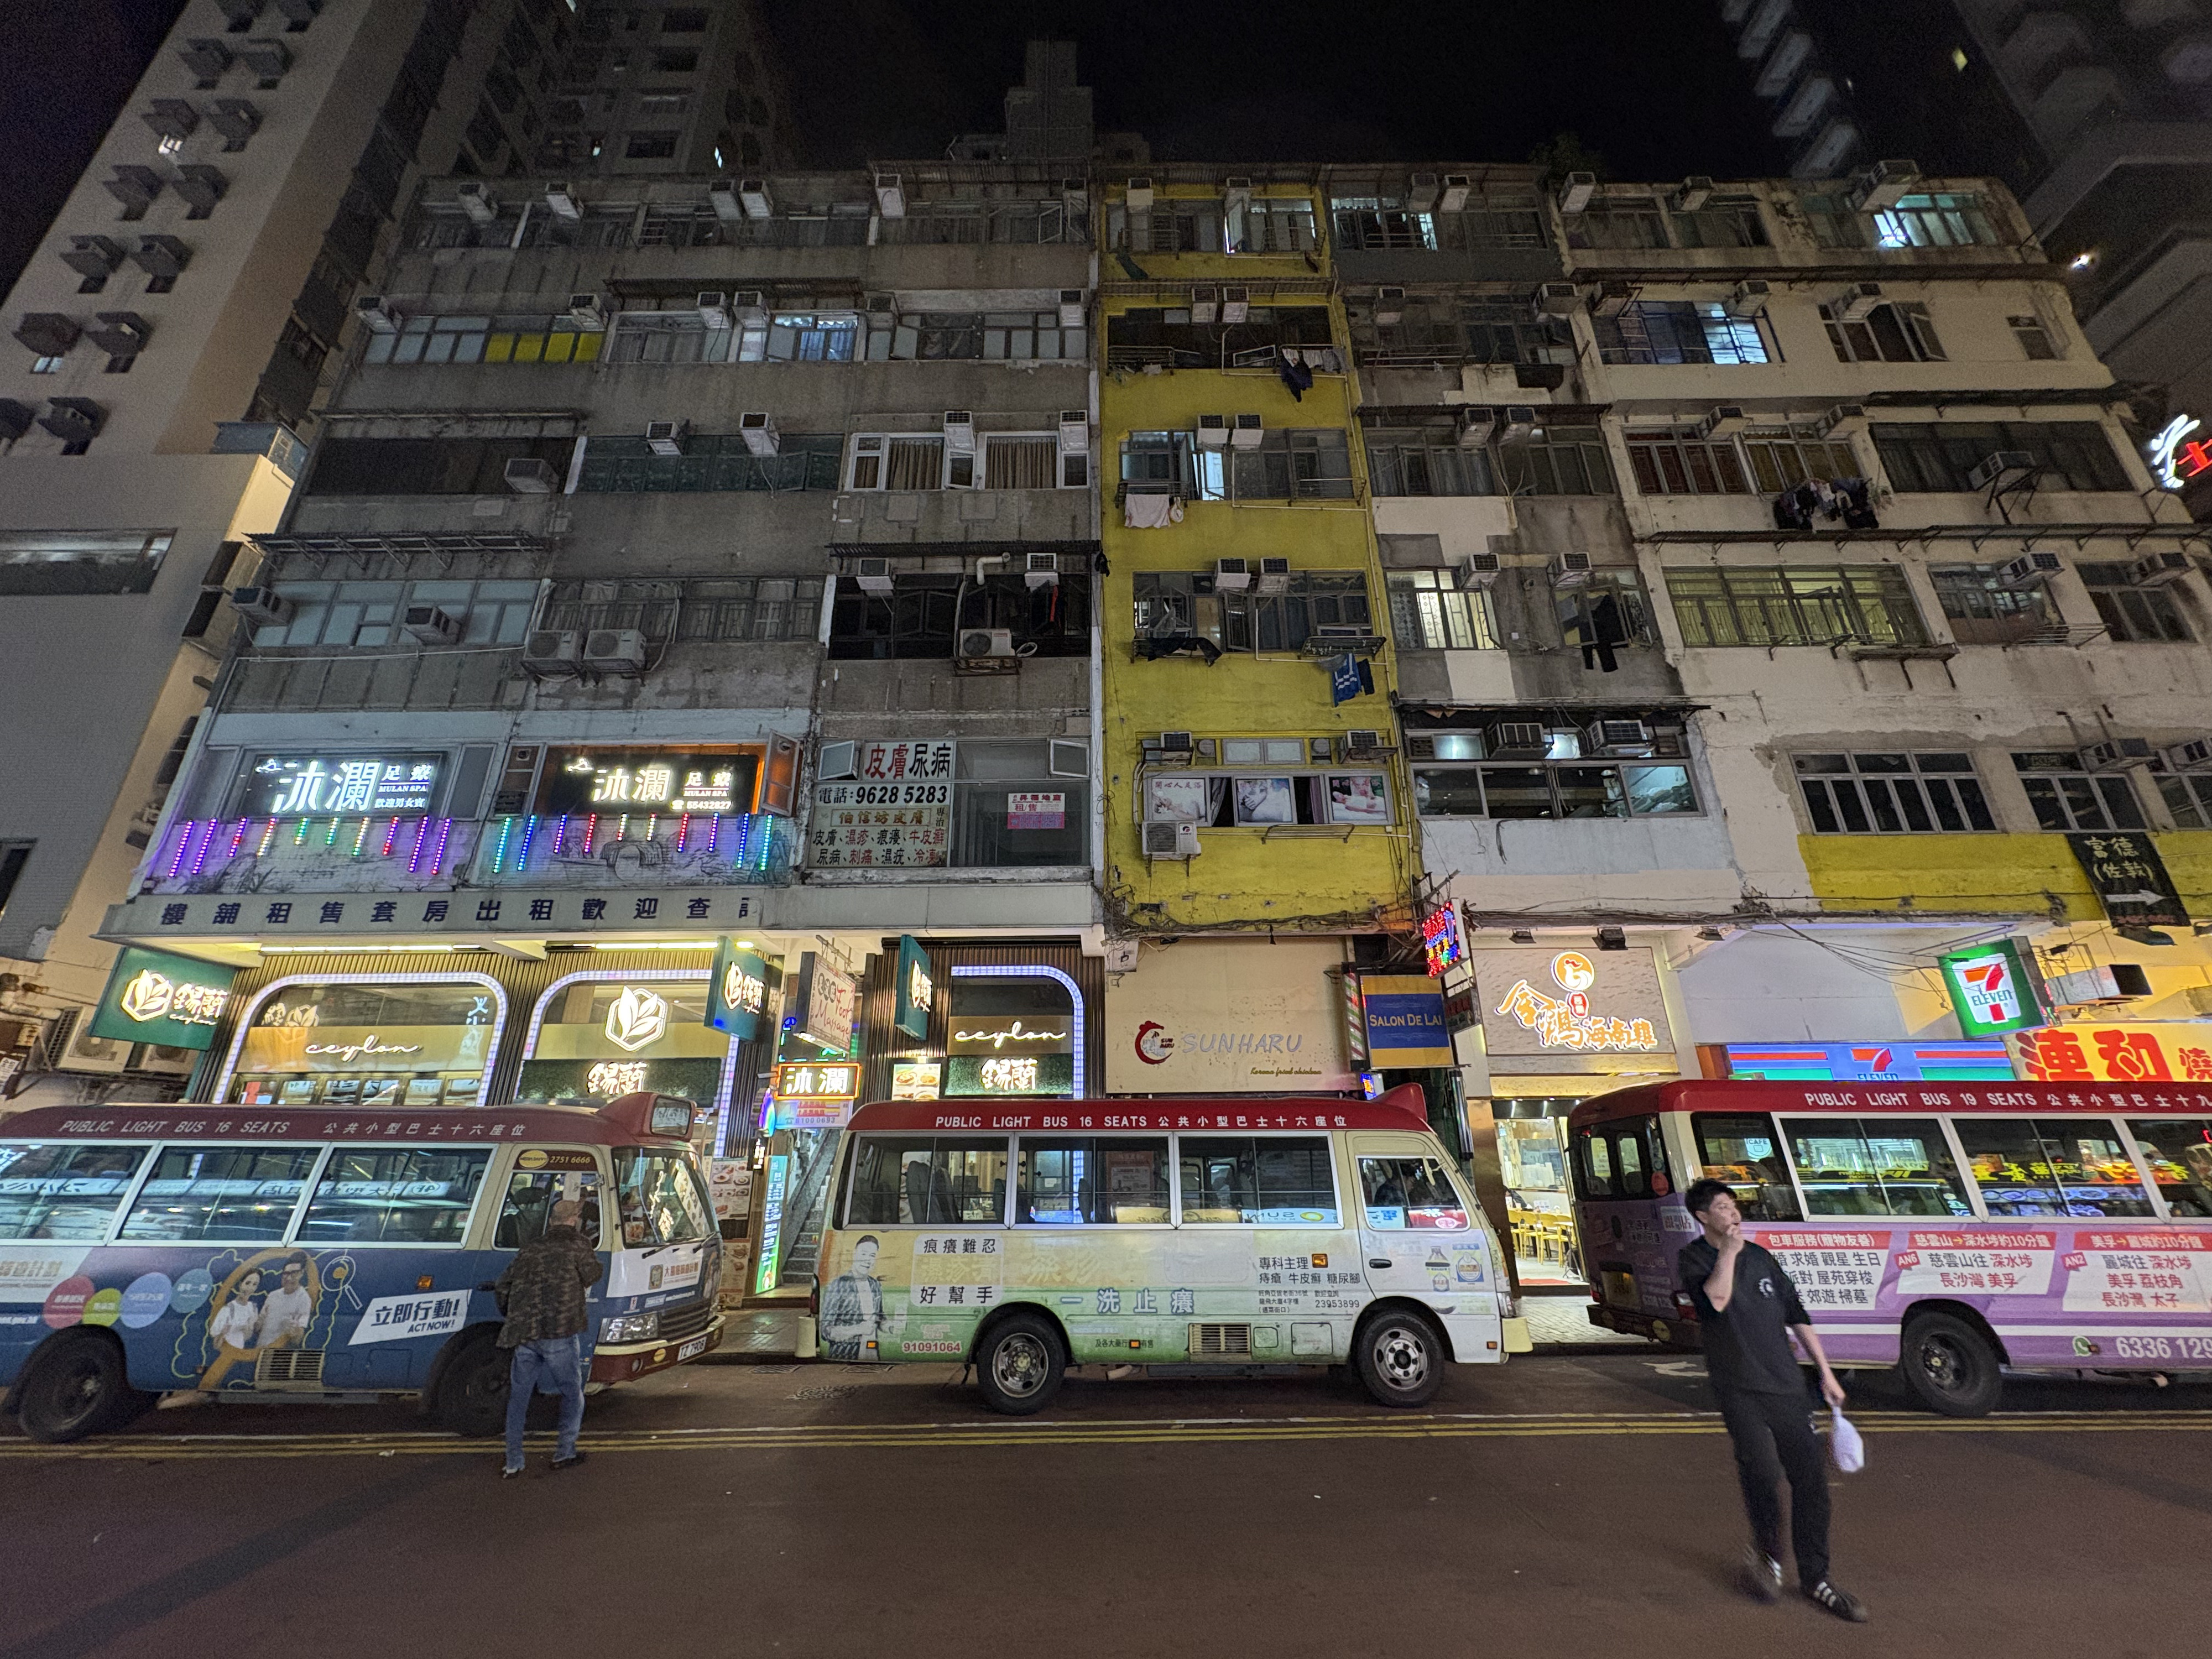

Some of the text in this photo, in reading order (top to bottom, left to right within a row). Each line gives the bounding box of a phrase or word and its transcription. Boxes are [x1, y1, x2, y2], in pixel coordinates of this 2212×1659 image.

[865, 742, 952, 780] 皮膚尿病
[855, 785, 899, 804] 9628
[904, 785, 948, 804] 5283
[1182, 1032, 1303, 1054] SUNHARU
[1804, 1093, 1857, 1106] PUBLIC
[1865, 1093, 1907, 1106] LIGHT
[1920, 1093, 1952, 1106] BUS
[1960, 1093, 1977, 1106] 19
[1986, 1093, 2037, 1106] SEATS
[59, 1120, 114, 1133] PUBLIC
[120, 1120, 169, 1133] LIGHT
[174, 1120, 207, 1133] BUS
[214, 1121, 232, 1133] 16
[240, 1121, 290, 1134] SEATS
[935, 1115, 1347, 1128] PUBLIC LIGHT BUS 16 SEATS 公共小型巴士十六座位
[1898, 1253, 1918, 1266] AN6
[2064, 1254, 2085, 1267] AN2
[407, 1322, 427, 1334] ACT
[902, 1340, 962, 1353] 91091064
[2116, 1337, 2172, 1359] 6336
